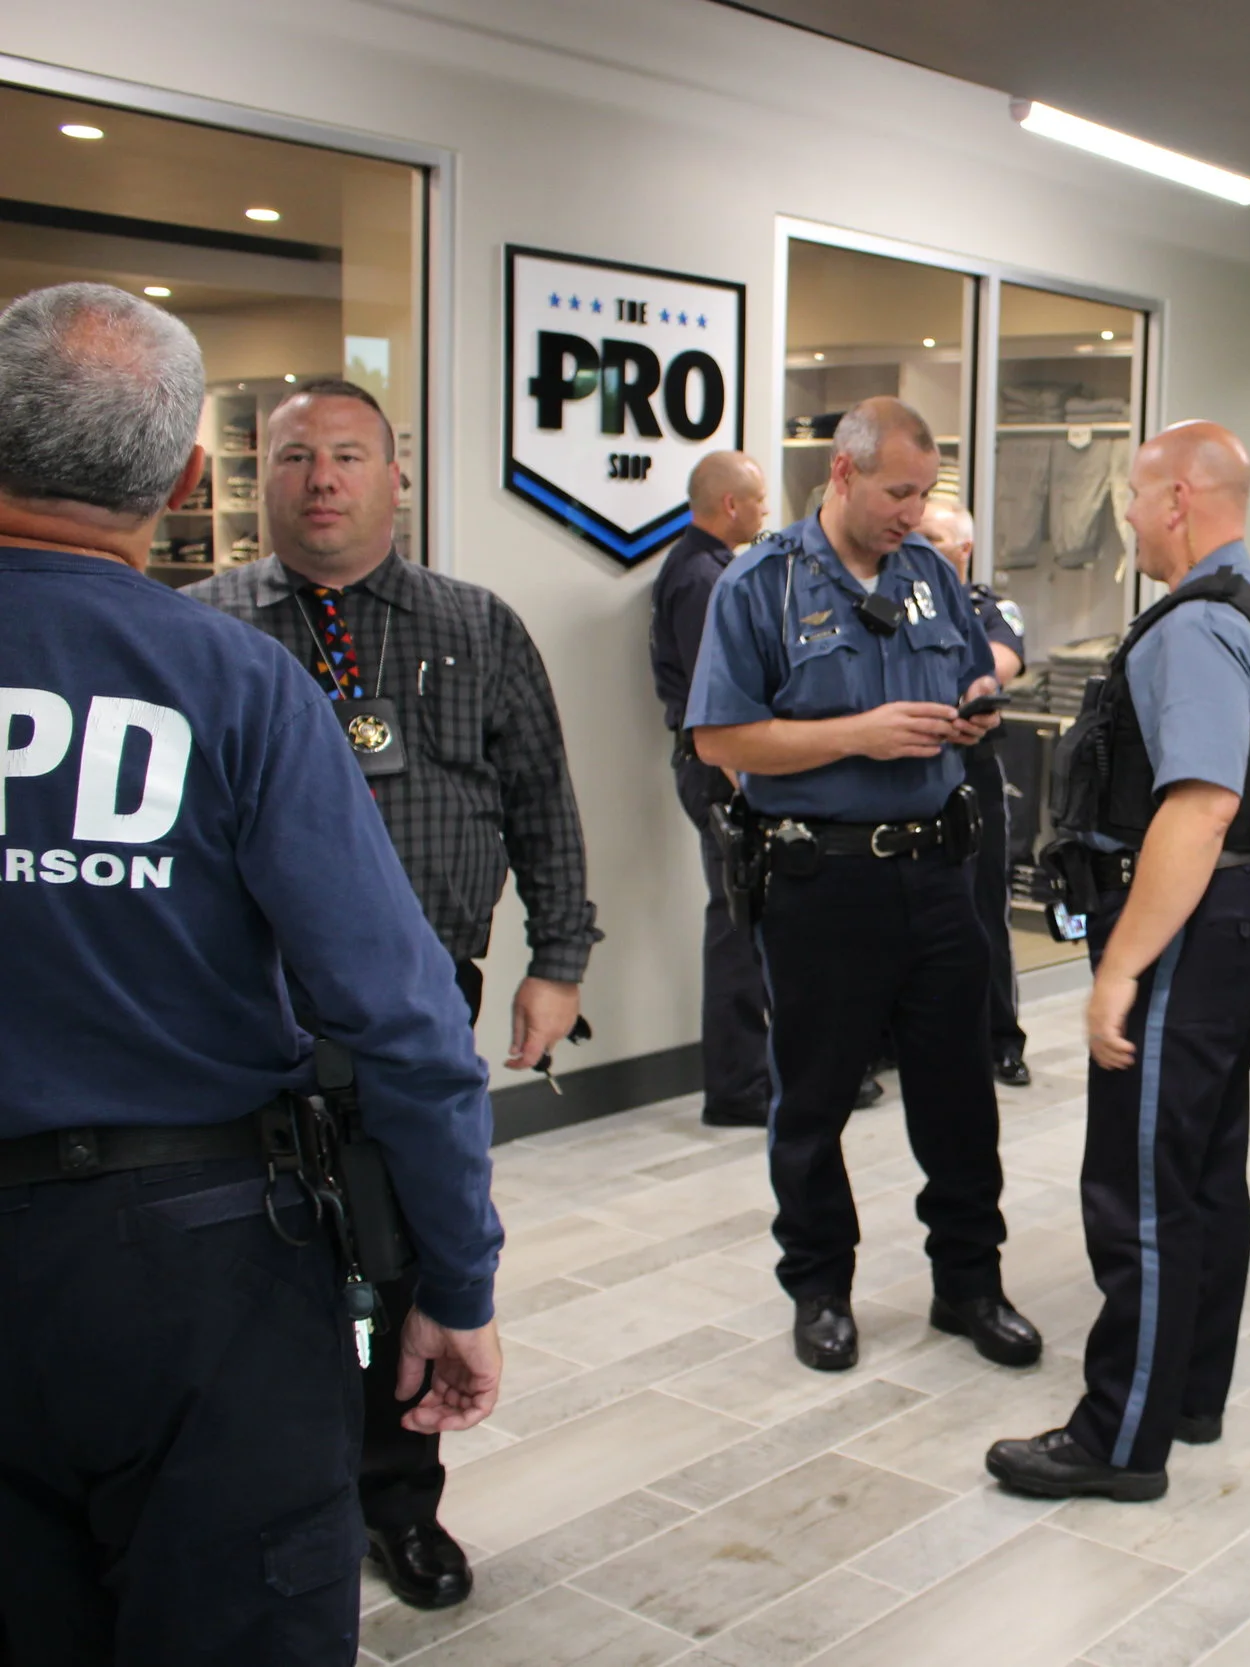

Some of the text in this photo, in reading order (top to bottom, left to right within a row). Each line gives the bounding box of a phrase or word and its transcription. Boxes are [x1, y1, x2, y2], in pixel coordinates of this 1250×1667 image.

[615, 298, 648, 326] THE
[528, 330, 725, 442] PRO
[608, 452, 652, 481] SHOP
[0, 848, 174, 889] RSON
